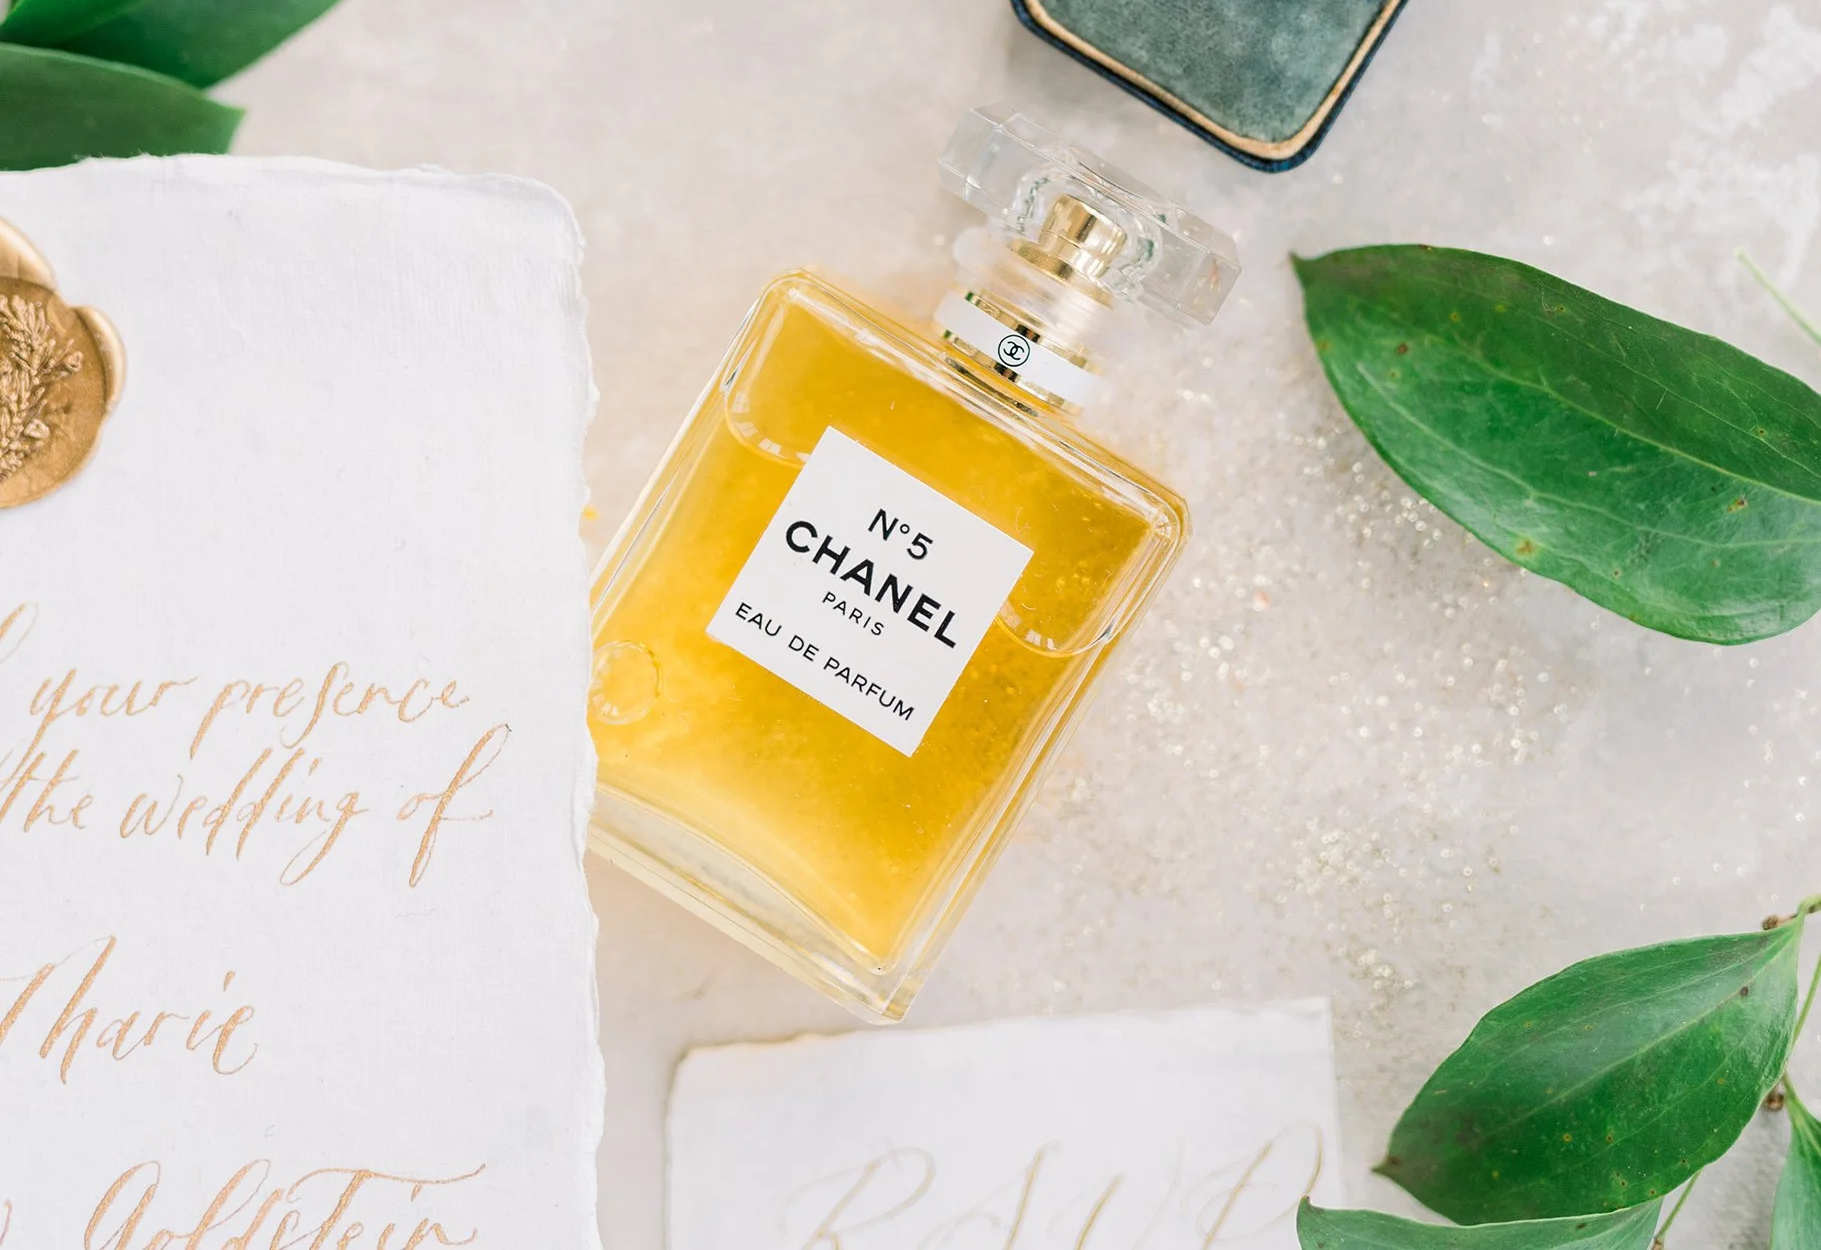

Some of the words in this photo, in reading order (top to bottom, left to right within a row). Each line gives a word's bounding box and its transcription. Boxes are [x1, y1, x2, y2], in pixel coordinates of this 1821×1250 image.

[785, 520, 957, 649] CHANEL
[822, 591, 885, 637] PARIS
[735, 602, 782, 637] EAU
[788, 635, 819, 662] DE
[823, 656, 915, 721] PARFUM
[0, 668, 199, 794] your
[189, 661, 470, 760] presence
[0, 749, 93, 833] the
[119, 747, 370, 887] wedding
[396, 722, 512, 889] of
